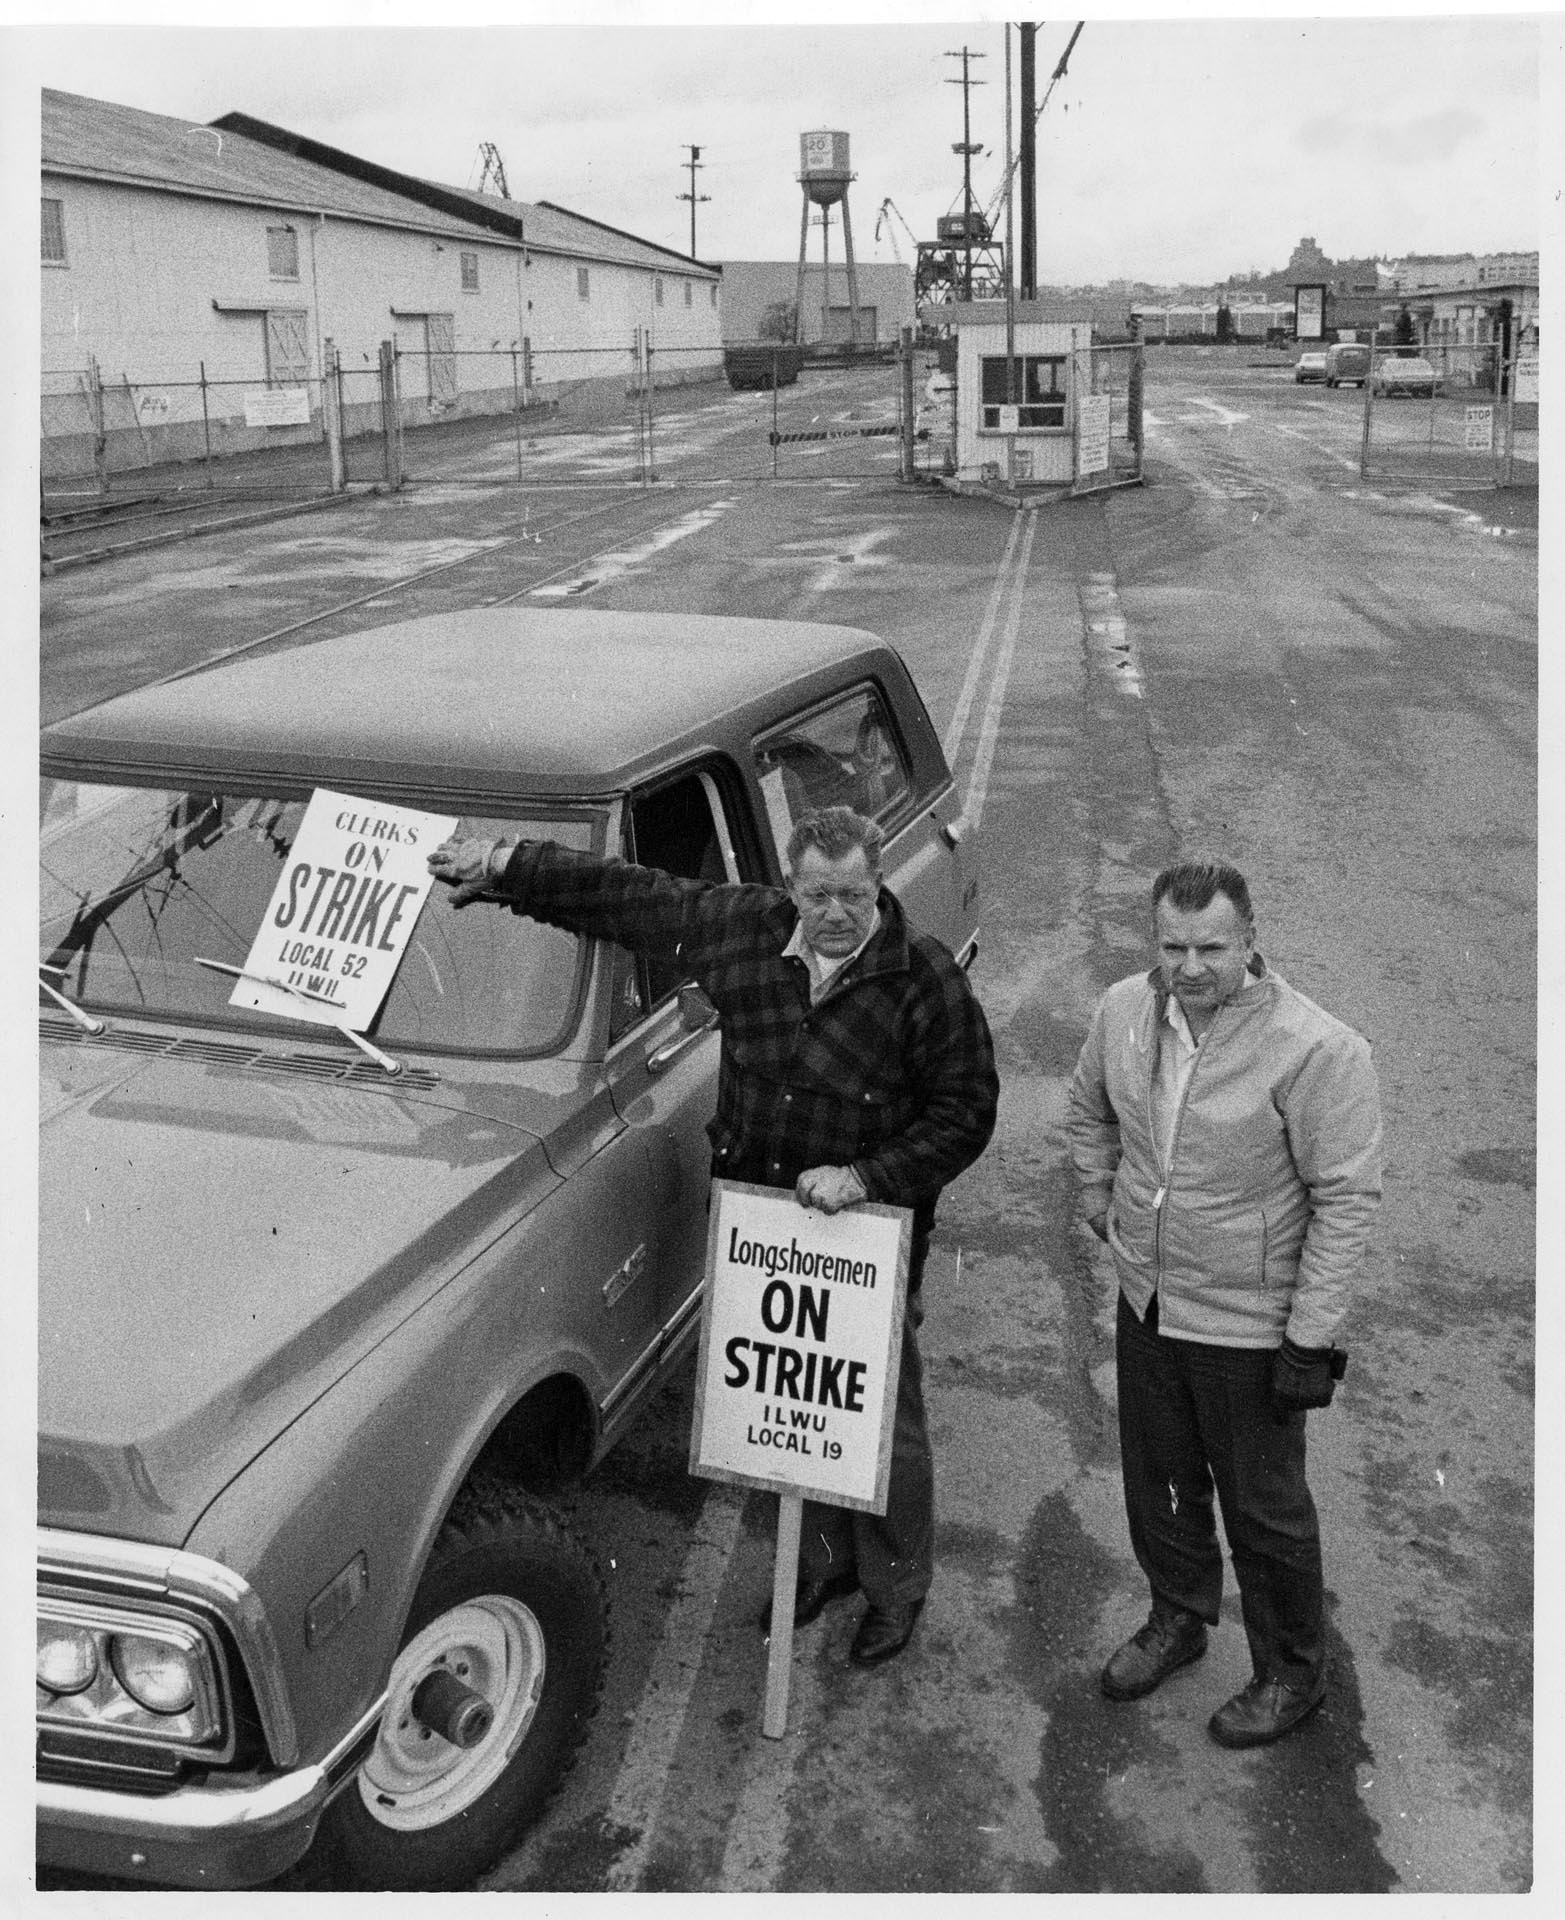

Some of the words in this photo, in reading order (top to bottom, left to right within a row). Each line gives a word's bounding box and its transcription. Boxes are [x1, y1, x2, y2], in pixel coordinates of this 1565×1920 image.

[1467, 409, 1490, 420] STOP
[829, 430, 859, 438] STOP
[336, 812, 419, 844] CLERKS
[344, 841, 390, 873] ON
[274, 863, 419, 951] STRIKE
[279, 940, 334, 972] LOCAL
[341, 954, 368, 979] 52
[728, 1226, 877, 1289] Longshoremen
[761, 1279, 831, 1342] ON
[724, 1336, 867, 1413] STRIKE
[763, 1405, 827, 1433] ILWU
[748, 1425, 812, 1455] LOCAL
[822, 1440, 843, 1461] 19
